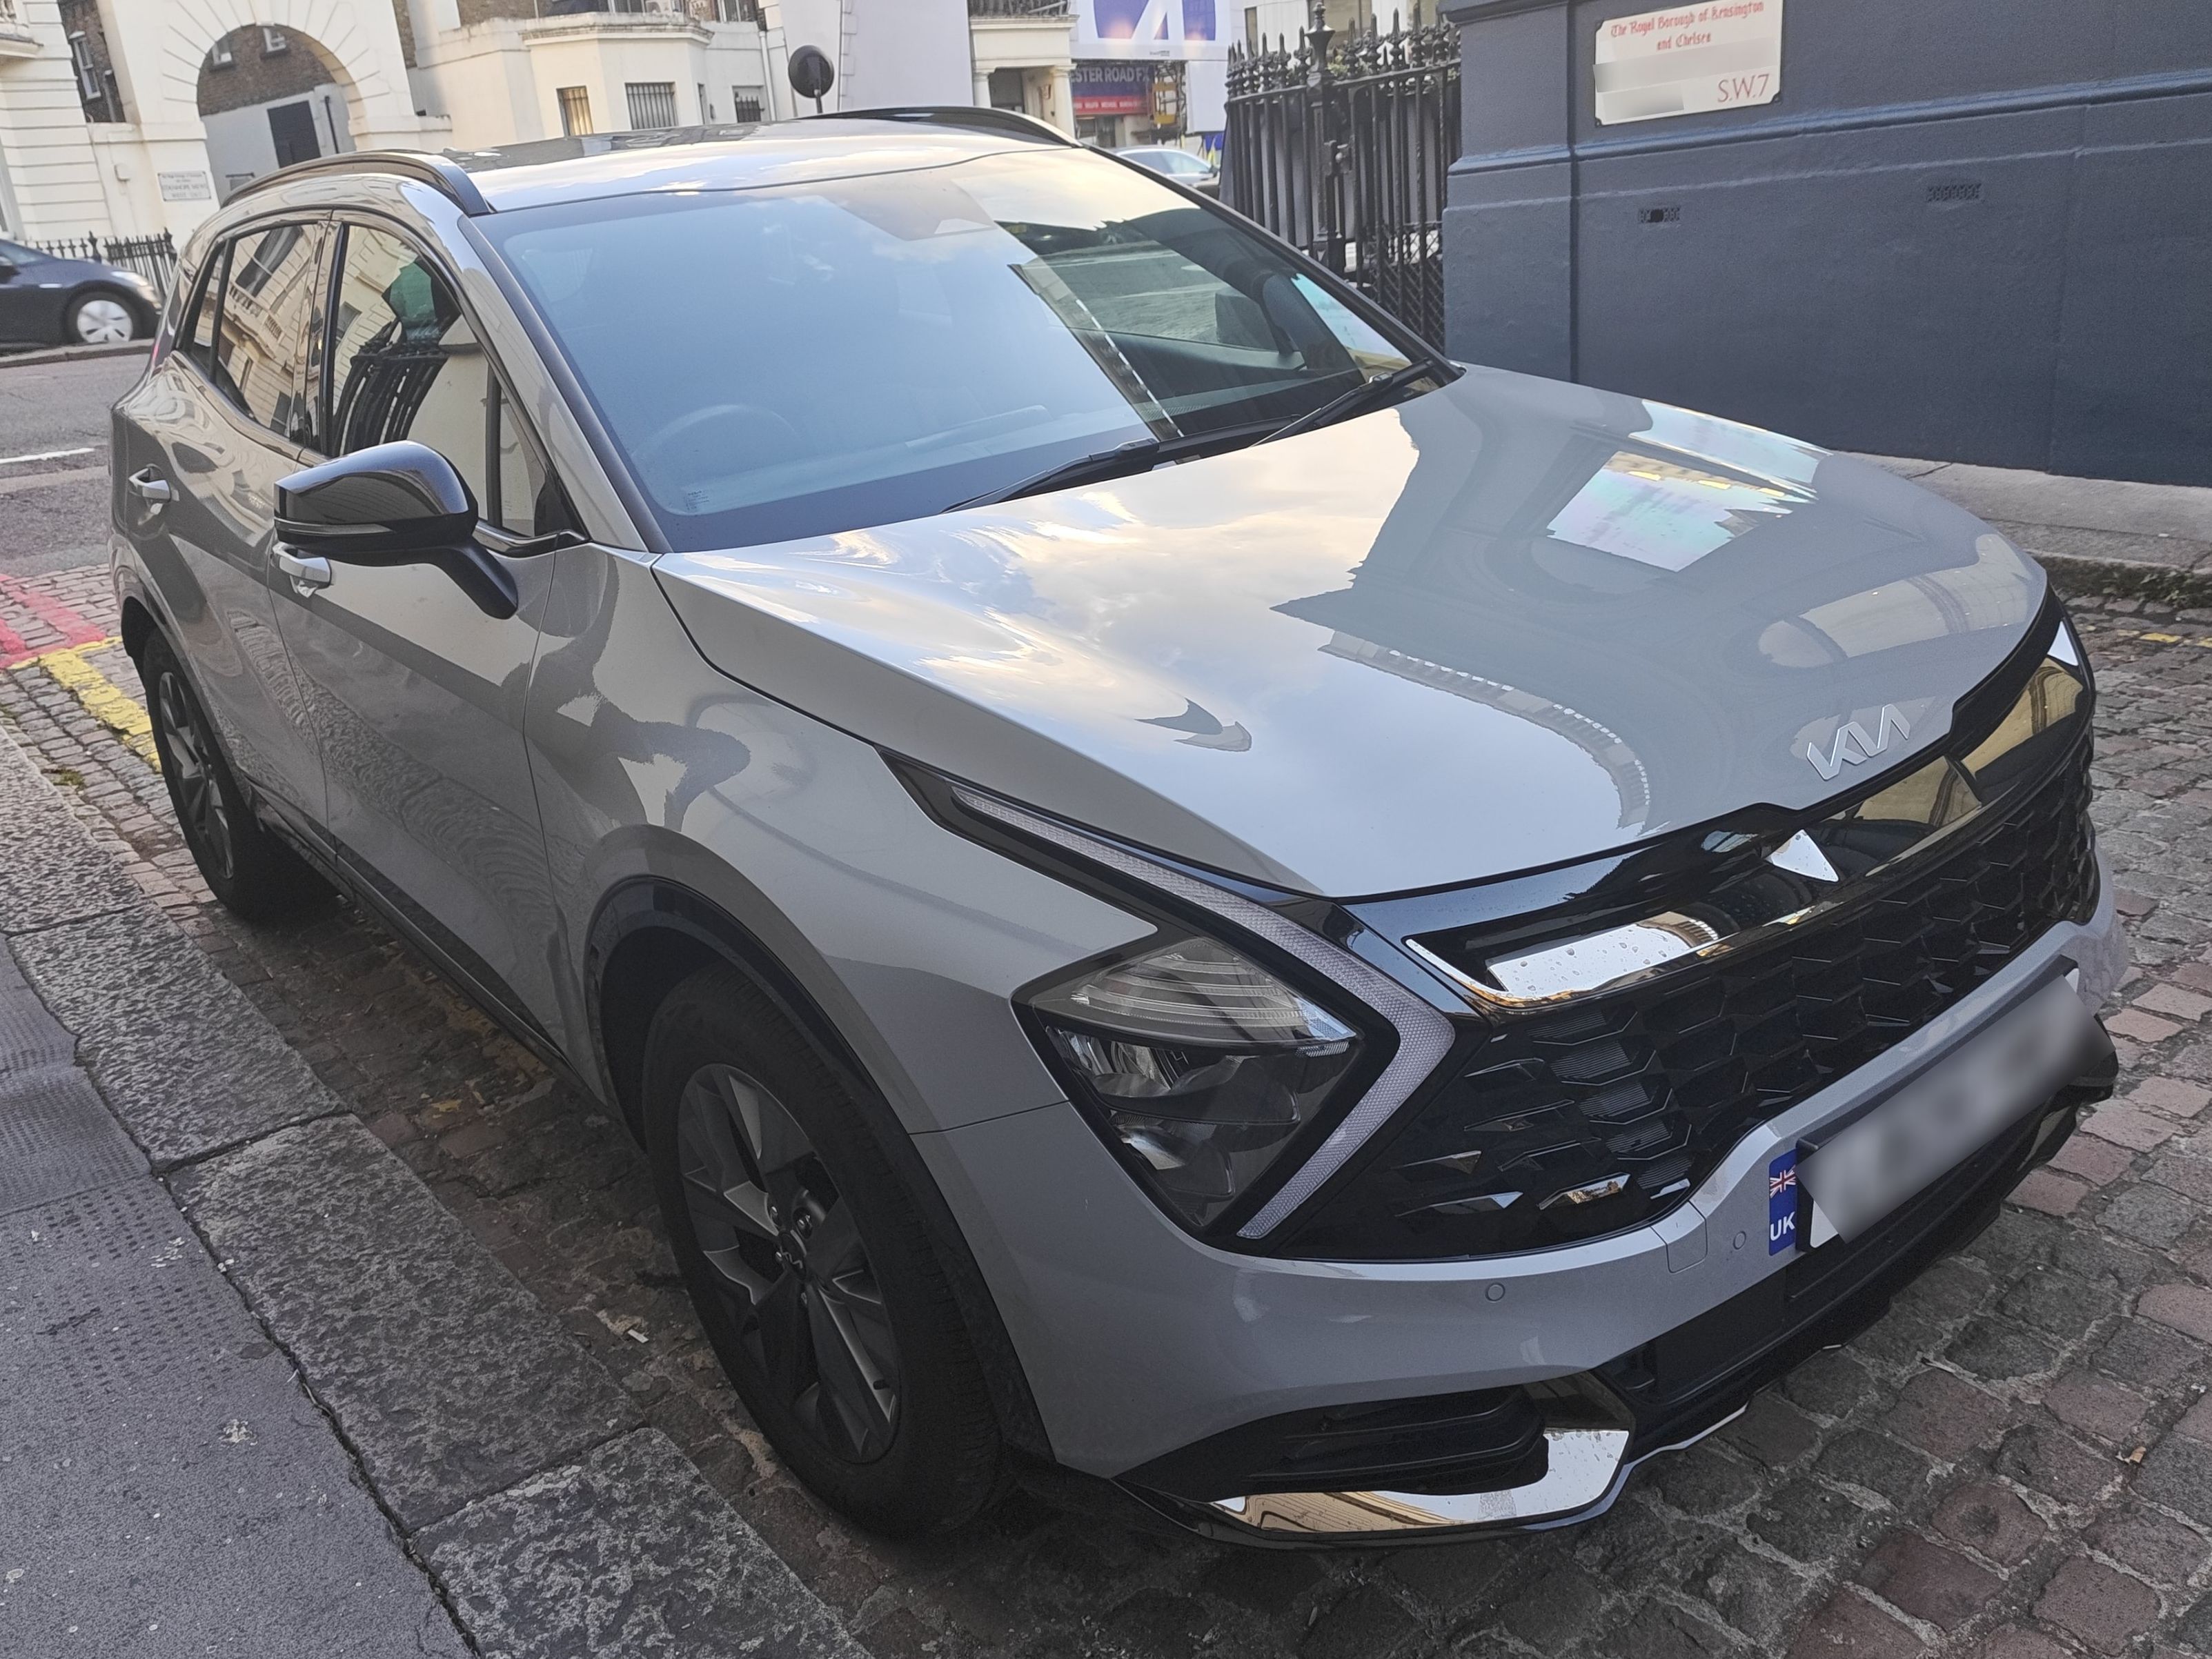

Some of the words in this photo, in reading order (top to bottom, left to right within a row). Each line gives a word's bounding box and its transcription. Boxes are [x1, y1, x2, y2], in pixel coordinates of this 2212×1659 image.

[1611, 24, 1626, 37] The
[1629, 18, 1655, 36] Royal
[1657, 12, 1695, 28] Borough
[1699, 8, 1708, 21] of
[1711, 1, 1764, 20] Kensington
[1657, 36, 1672, 50] and
[1675, 32, 1711, 48] Chelsea
[1104, 67, 1135, 82] ROAD
[1806, 703, 1910, 781] KIA
[1770, 1211, 1795, 1241] UK
